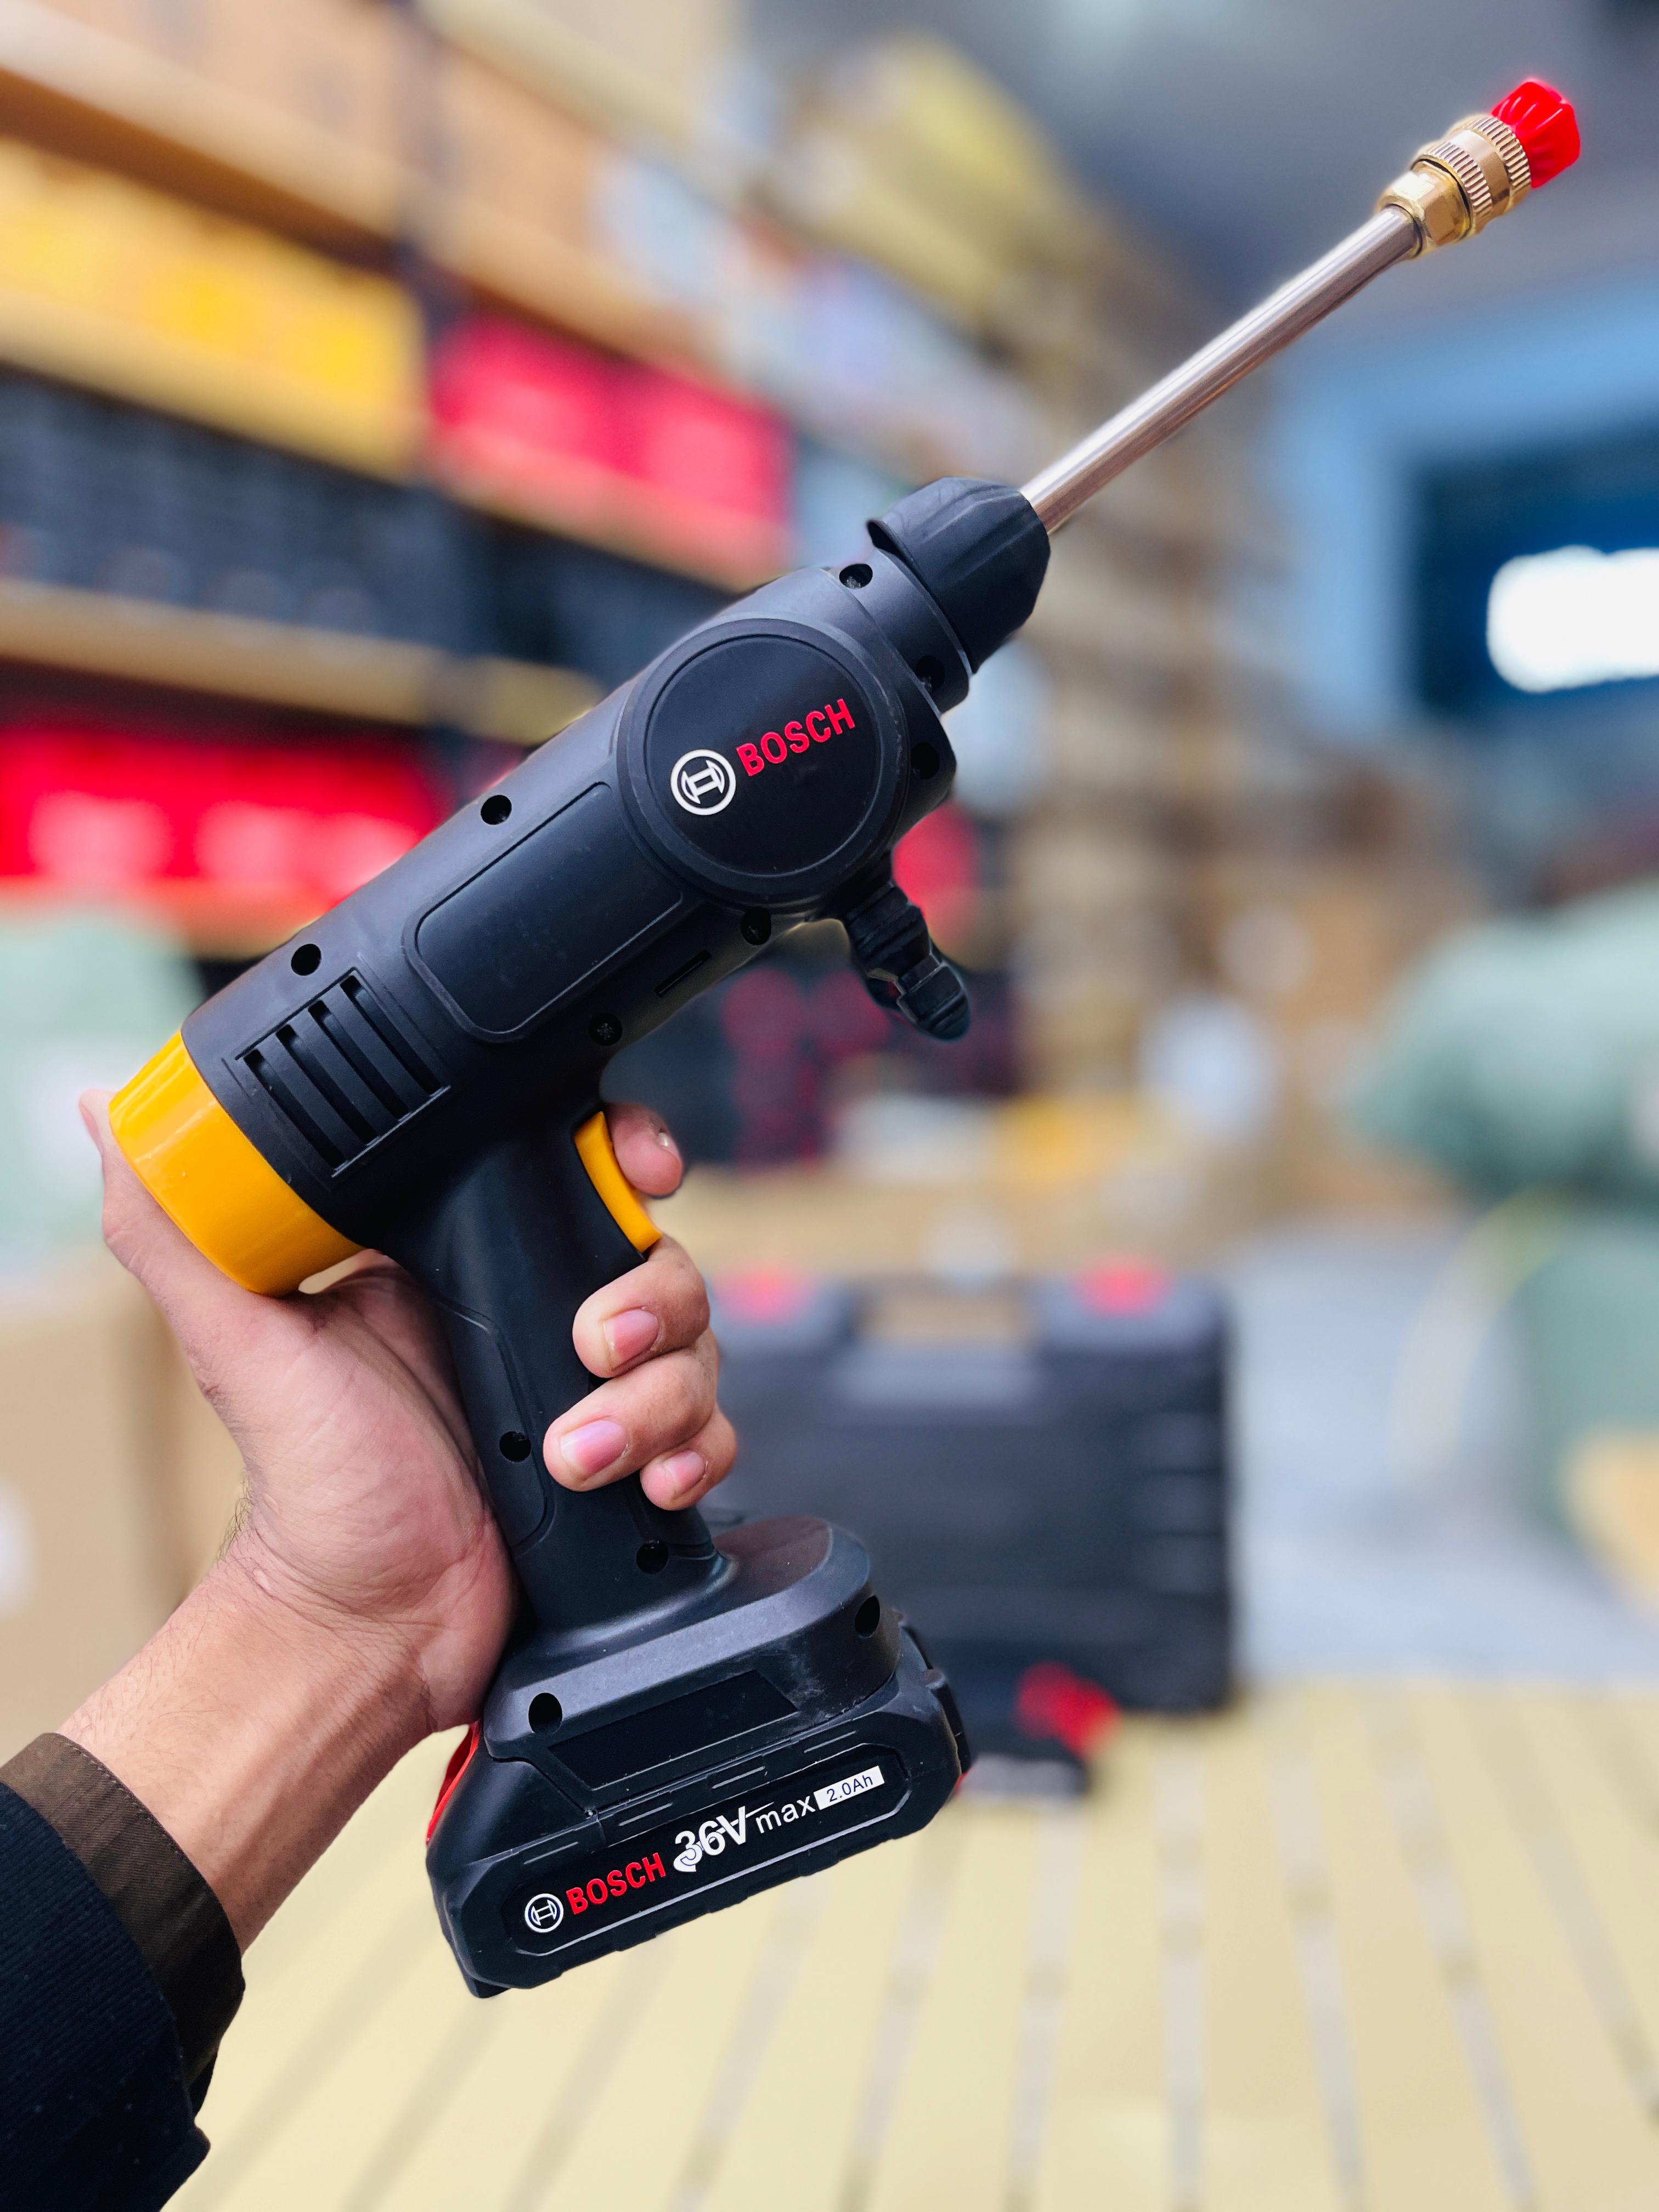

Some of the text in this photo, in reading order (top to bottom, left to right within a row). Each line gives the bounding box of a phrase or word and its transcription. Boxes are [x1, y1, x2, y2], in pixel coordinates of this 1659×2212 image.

[736, 698, 855, 776] BOSCH
[566, 1774, 874, 1915] BOSCH 36V max 2.0Ah
